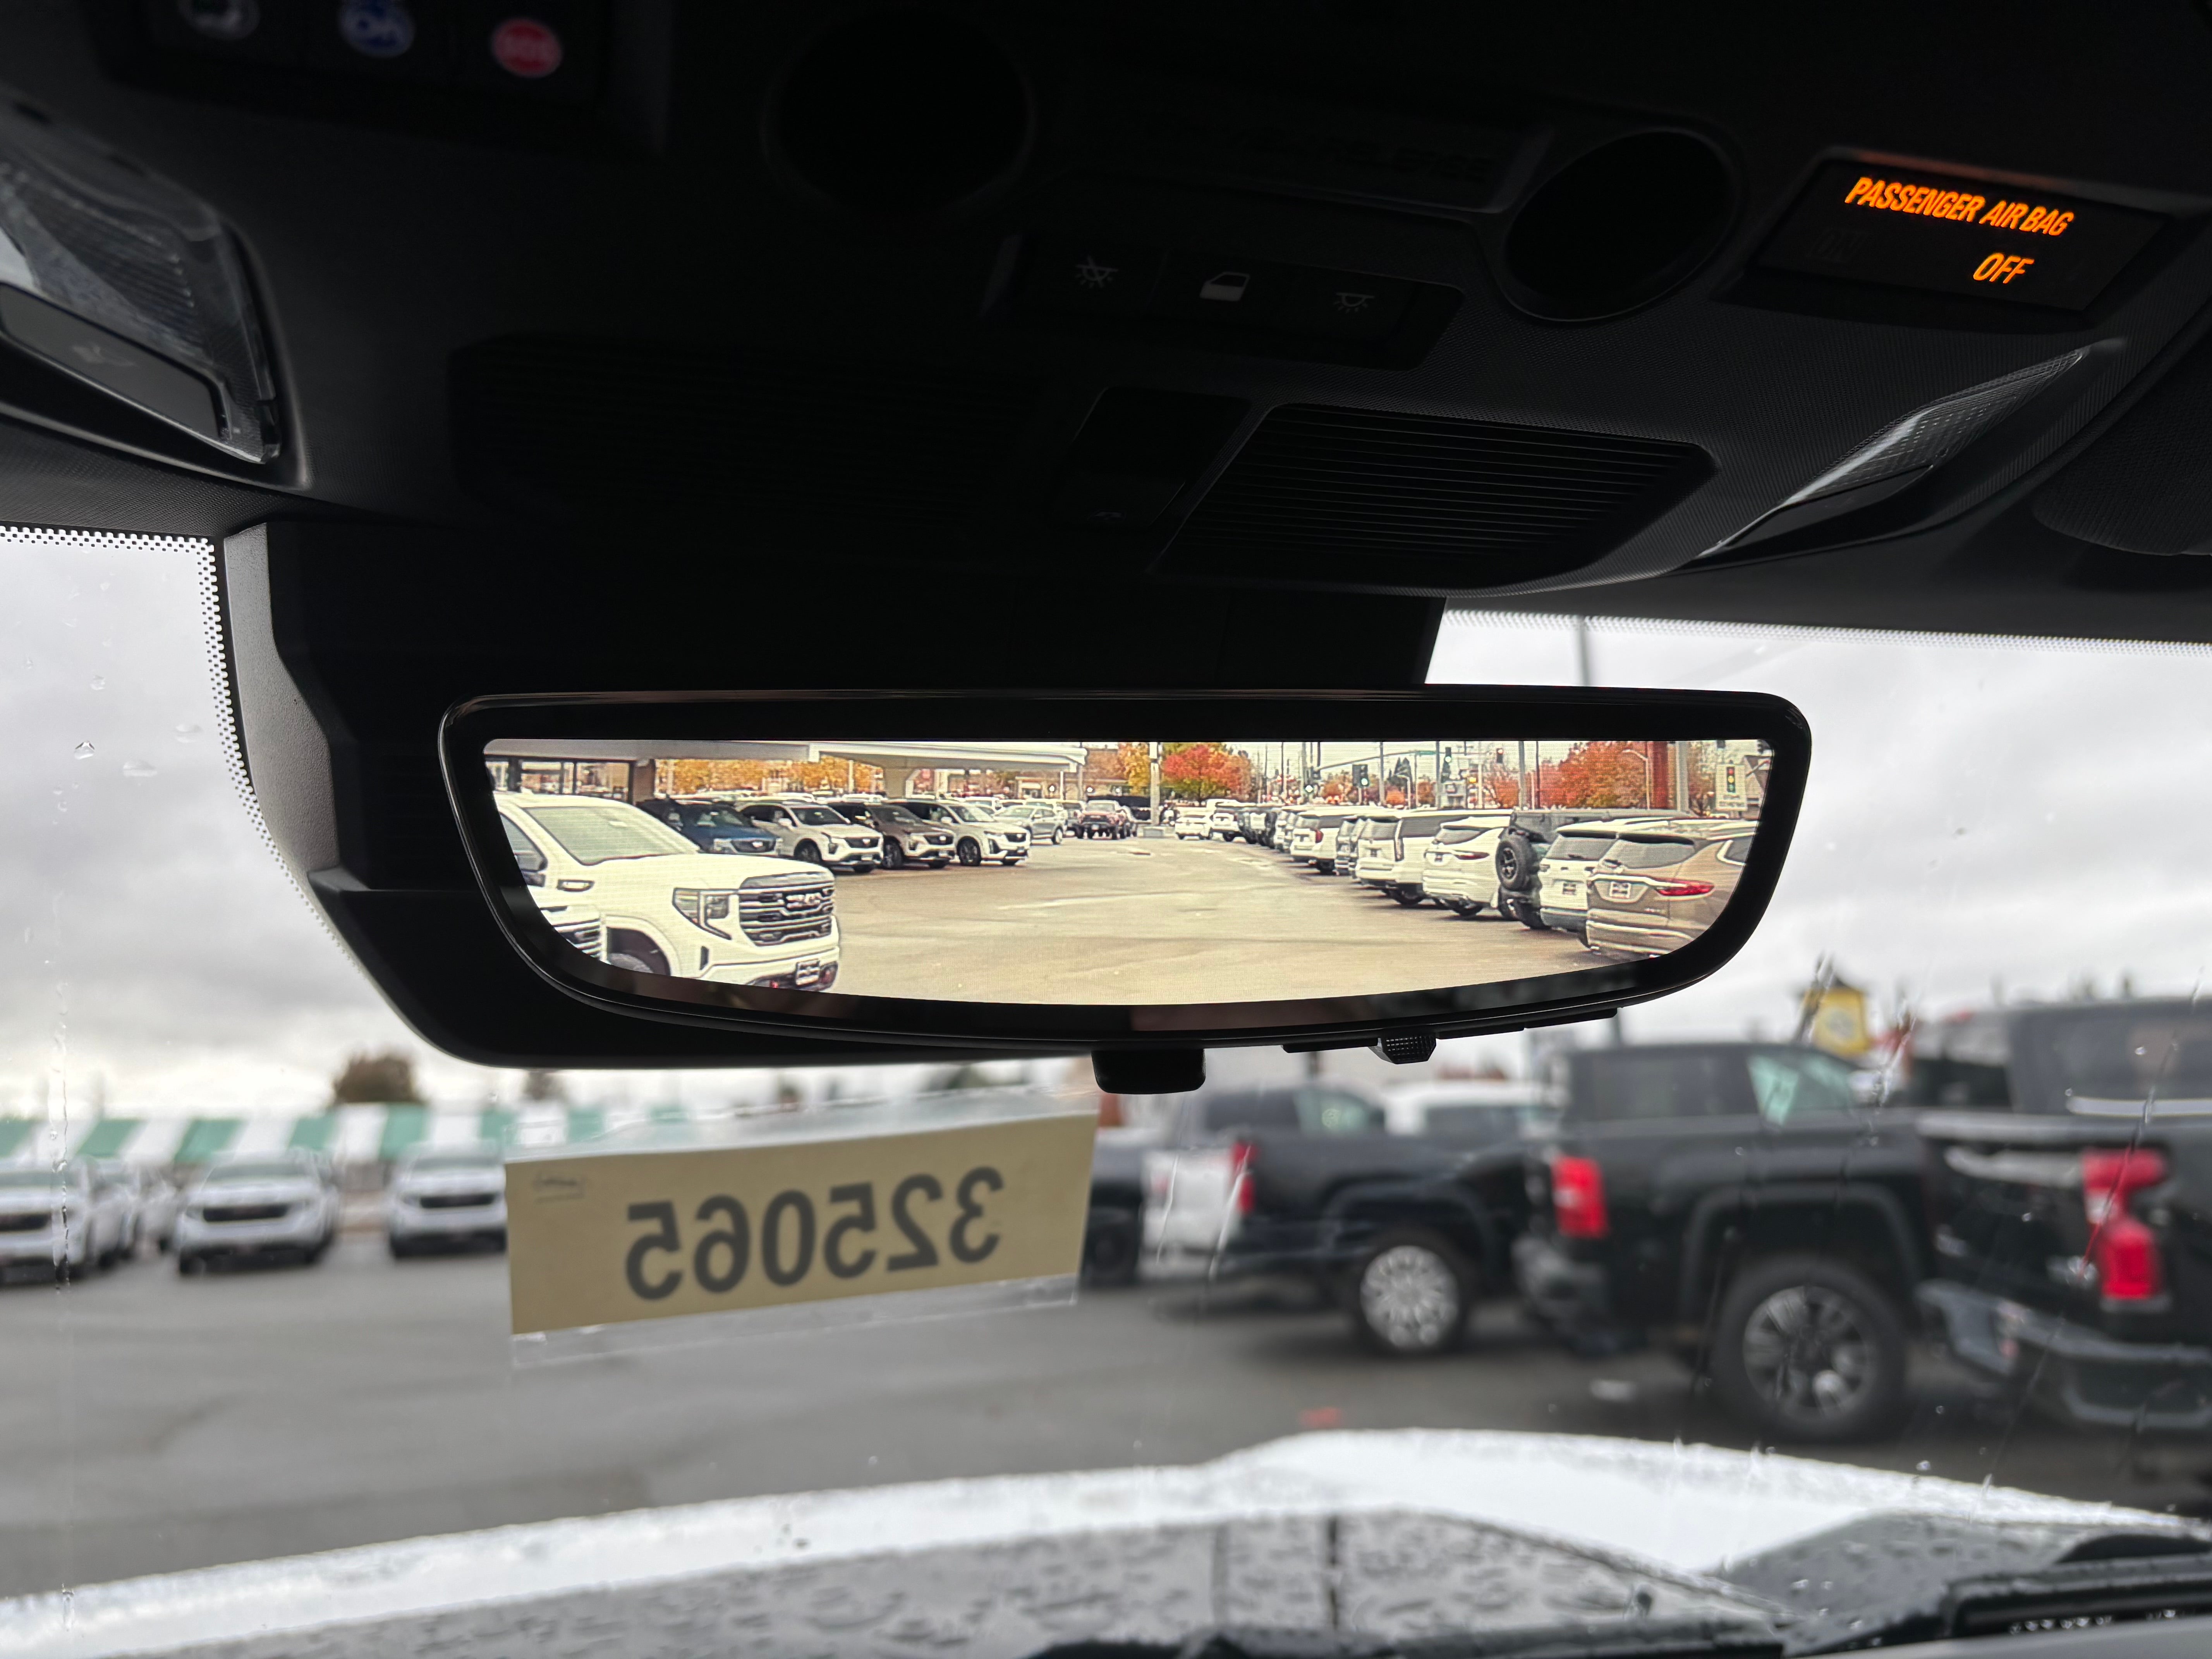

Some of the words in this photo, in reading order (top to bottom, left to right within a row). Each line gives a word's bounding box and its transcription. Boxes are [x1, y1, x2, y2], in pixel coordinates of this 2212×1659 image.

[1844, 177, 1985, 222] PASSENGER
[1978, 200, 2029, 230] AIR
[2019, 206, 2074, 236] BAG
[1973, 252, 2035, 284] OFF
